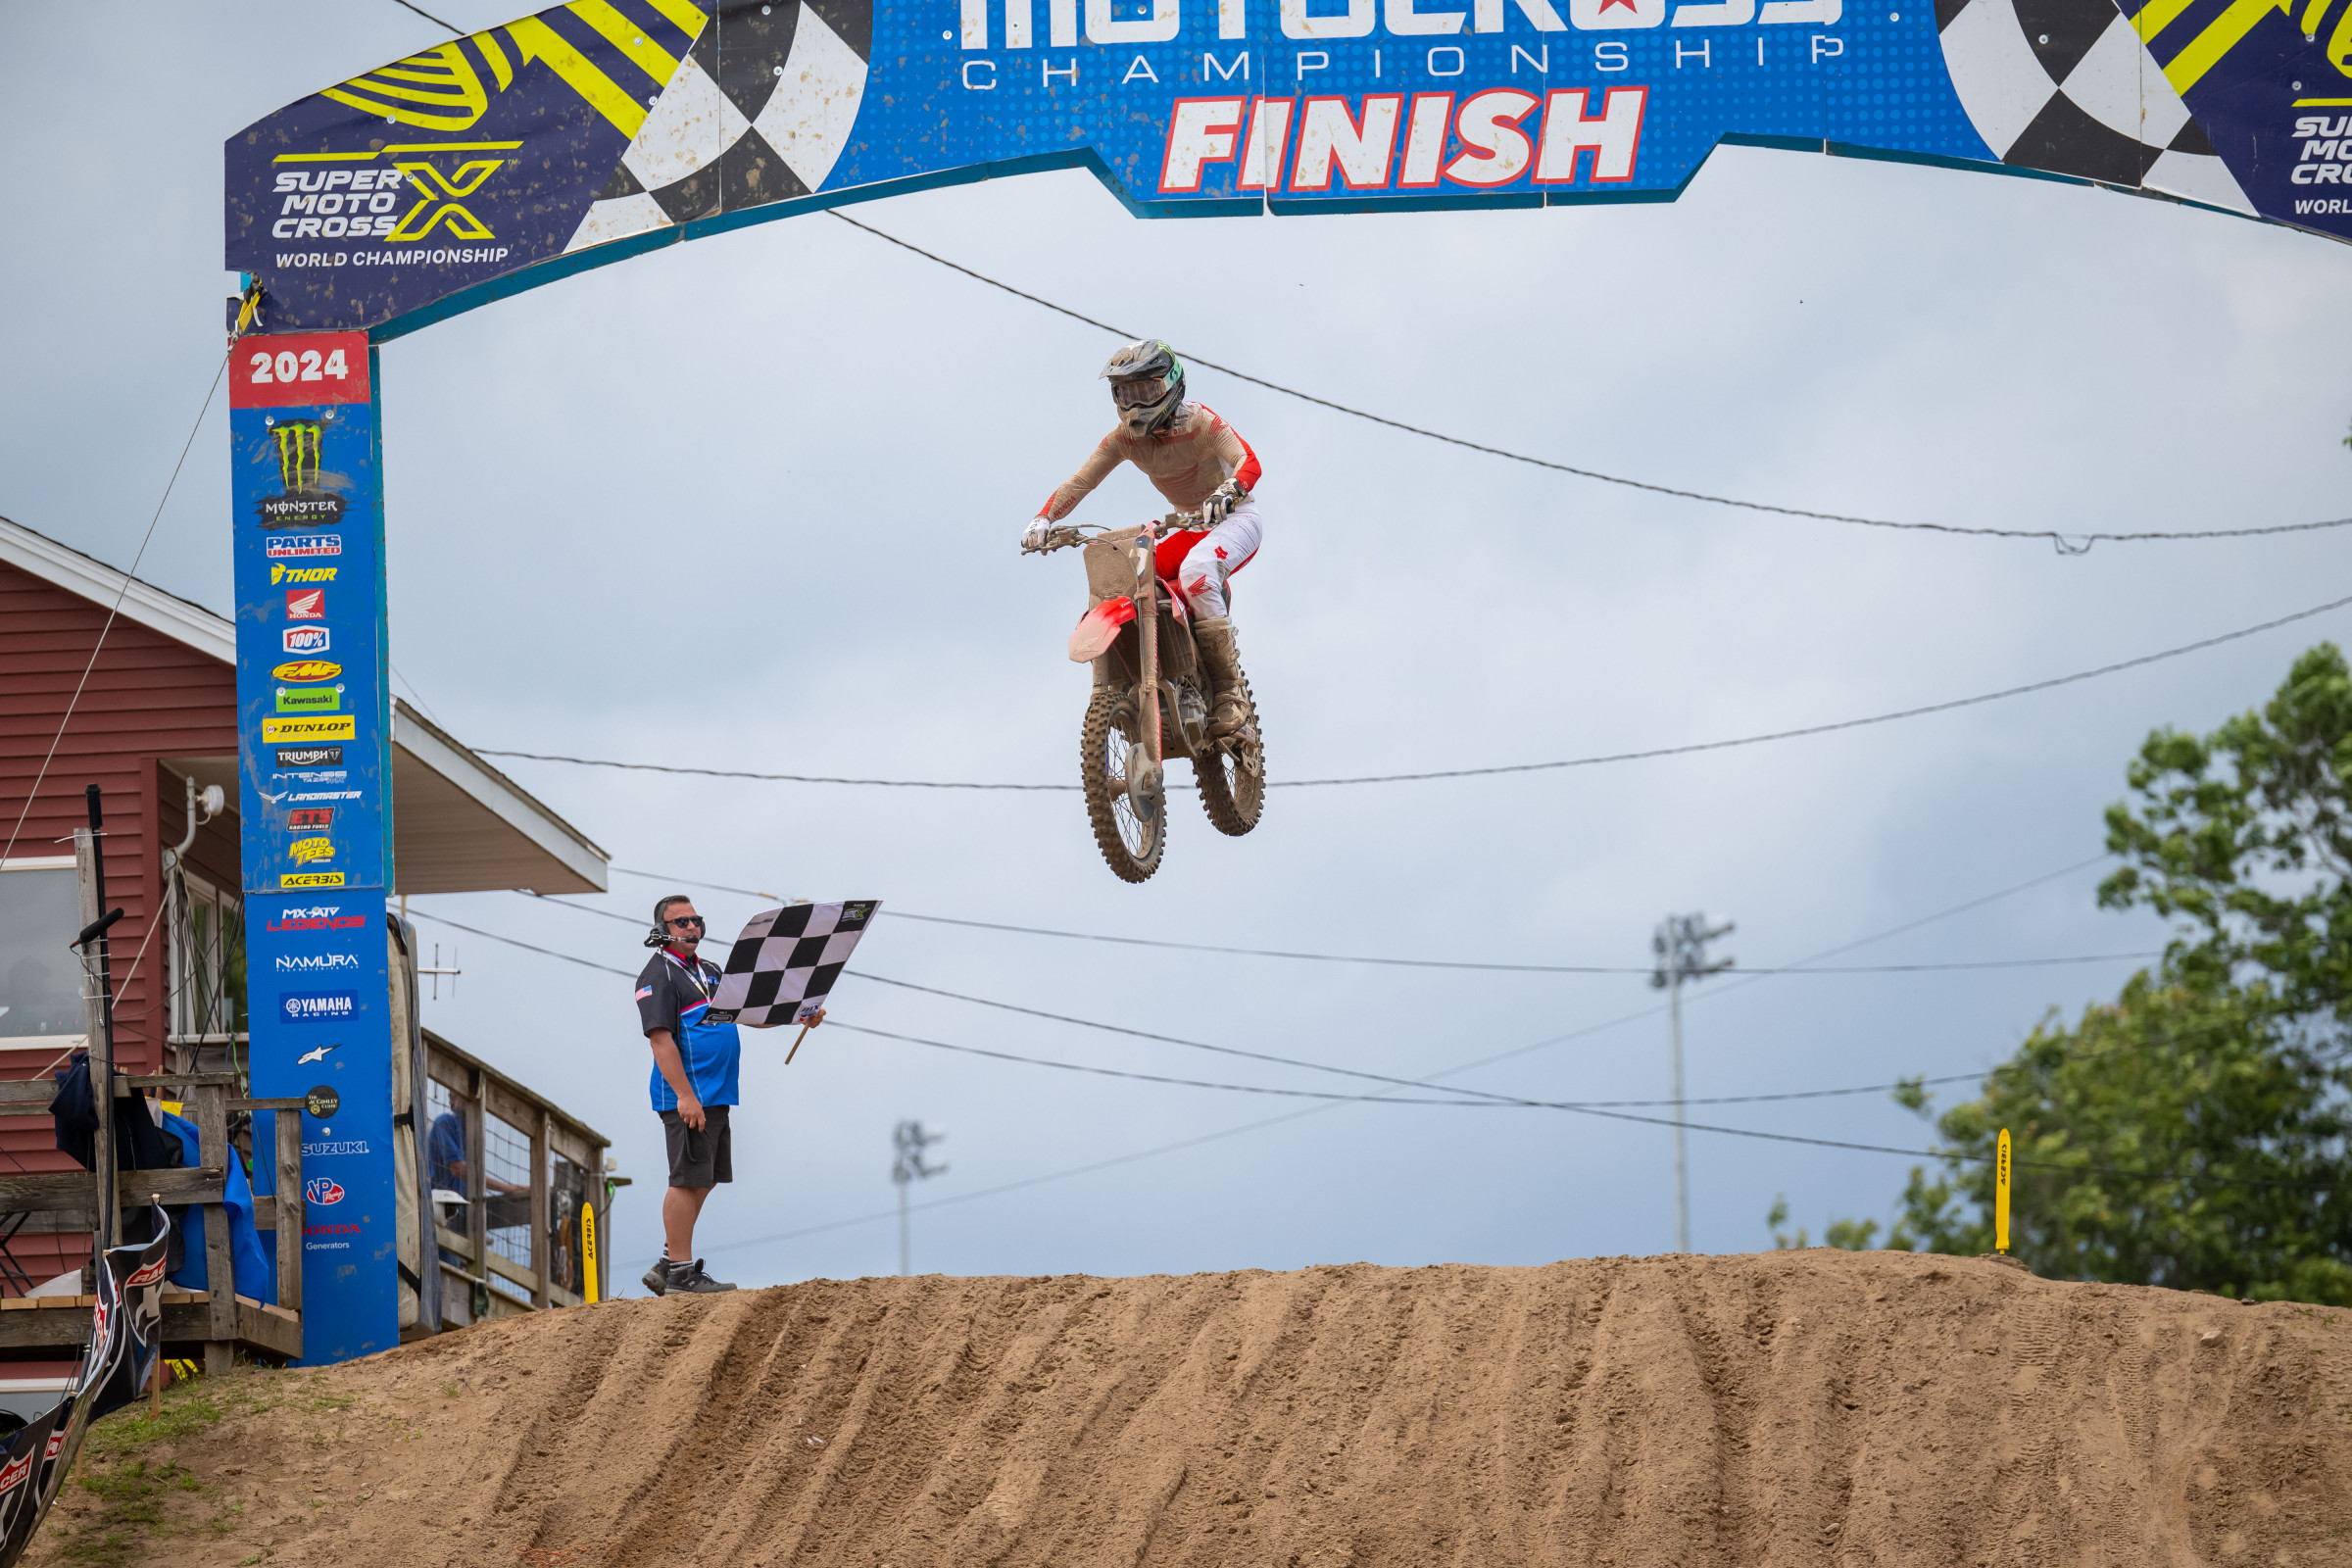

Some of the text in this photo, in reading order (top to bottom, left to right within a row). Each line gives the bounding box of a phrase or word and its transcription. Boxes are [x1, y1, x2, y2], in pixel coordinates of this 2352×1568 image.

[962, 35, 1844, 90] CHAMPIONSHIP
[2291, 116, 2352, 137] SU
[1157, 85, 1649, 193] FINISH
[272, 169, 404, 193] SUPER
[280, 192, 397, 216] MOTO
[271, 215, 399, 239] CROSS
[275, 247, 509, 269] WORLD CHAMPIONSHIP
[250, 349, 349, 384] 2024
[266, 500, 338, 514] MONSTER
[1053, 495, 1077, 518] HONDA
[267, 534, 341, 549] PARTS
[268, 547, 341, 557] UNLIMITED
[285, 567, 338, 583] THOR
[289, 631, 323, 648] 100%
[273, 662, 342, 678] FMF
[282, 695, 333, 706] Kawasaki
[279, 722, 352, 733] DUNLOP
[277, 750, 329, 763] TRIUMPH
[272, 770, 348, 780] INTENSE
[287, 790, 363, 802] LANDMASTER
[290, 808, 334, 825] ETS
[288, 836, 331, 859] MOTO
[295, 846, 336, 867] TEES
[283, 874, 343, 886] ACERBIS
[282, 907, 308, 919] MX
[267, 915, 367, 932] LEGENDS
[275, 953, 359, 969] NAMURA
[301, 997, 353, 1012] YAMAHA
[301, 1141, 368, 1156] SUZUKI
[307, 1177, 334, 1205] VP
[306, 1242, 350, 1250] Generators
[585, 1217, 594, 1260] ACERBIS
